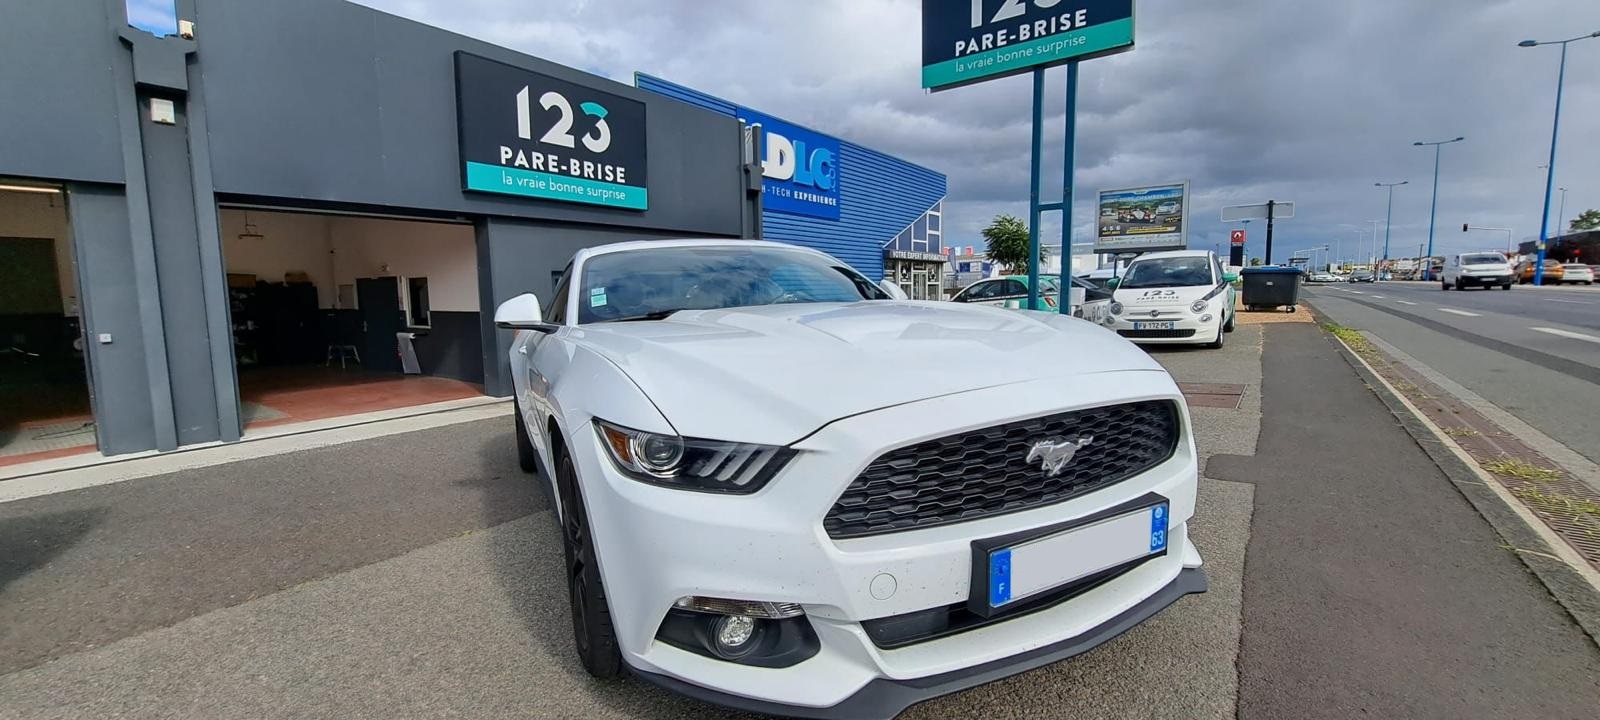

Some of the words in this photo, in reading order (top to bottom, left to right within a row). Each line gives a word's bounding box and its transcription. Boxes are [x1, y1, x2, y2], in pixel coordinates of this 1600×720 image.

[955, 9, 1087, 56] PARE-BRISE
[956, 62, 965, 73] la
[967, 56, 993, 70] vraie
[997, 48, 1033, 63] bonne
[1036, 34, 1087, 55] surprise
[516, 85, 611, 153] 123
[500, 146, 626, 183] PARE-BRISE
[502, 170, 513, 185] la
[516, 175, 546, 190] vraie
[550, 176, 584, 194] bonne
[587, 186, 626, 202] surprise
[761, 185, 791, 197] H-TECH
[794, 191, 837, 206] EXPERIENCE
[1152, 530, 1164, 547] 63
[998, 583, 1004, 595] F
